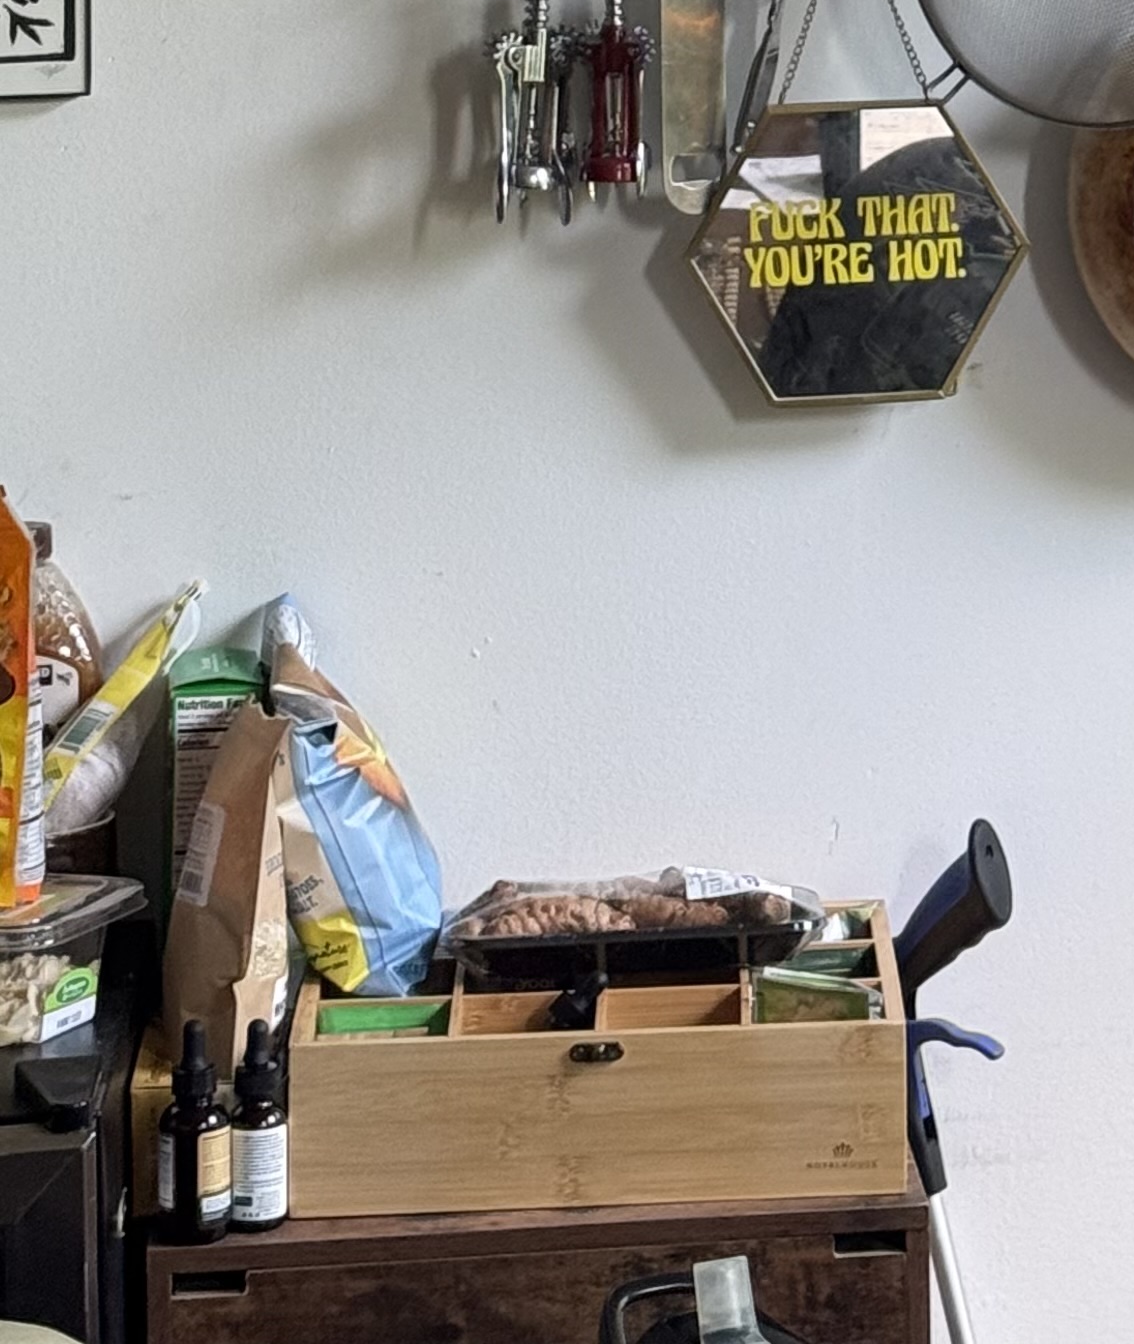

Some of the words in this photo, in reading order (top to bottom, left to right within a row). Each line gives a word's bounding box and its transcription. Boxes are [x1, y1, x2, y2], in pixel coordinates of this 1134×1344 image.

[750, 198, 846, 241] FUCK
[857, 193, 960, 237] THAT.
[744, 242, 875, 288] YOU'RE
[888, 237, 967, 282] HOT.
[177, 700, 224, 710] Nutrition
